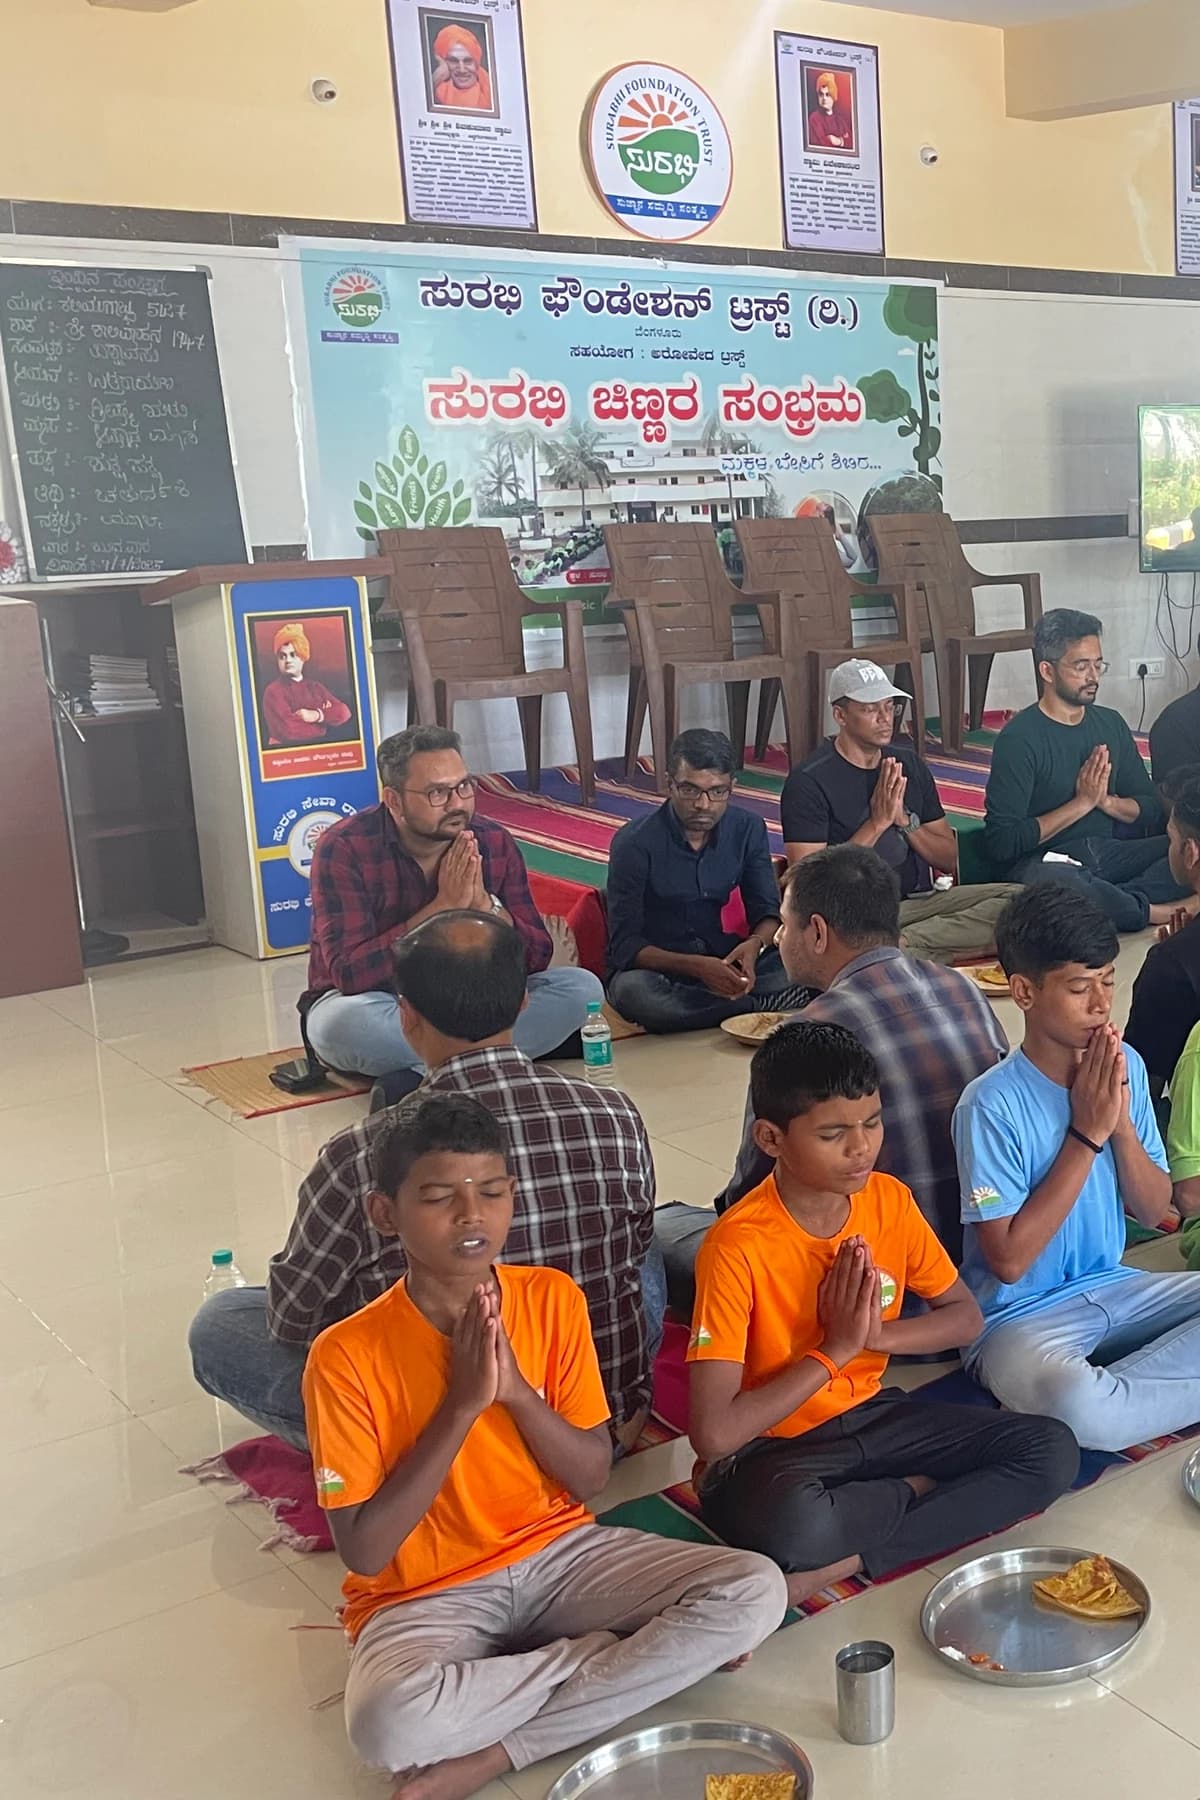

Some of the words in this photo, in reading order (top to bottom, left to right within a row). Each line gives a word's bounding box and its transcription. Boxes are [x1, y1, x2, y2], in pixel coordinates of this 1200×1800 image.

[605, 88, 626, 151] SURABHI
[624, 78, 701, 117] FOUNDATION
[697, 117, 713, 165] TRUST
[626, 148, 699, 184] ಸುರಭಿ
[419, 272, 522, 315] ಸುರಭಿ
[541, 277, 712, 319] ಫೌಂಡೇಶನ್
[729, 292, 792, 338] ಟ್ರಸ್ಟ್
[808, 296, 859, 331] (ರಿ.)
[172, 330, 206, 352] 1947
[634, 326, 682, 338] ಬೆಂಗಳೂರು
[570, 345, 634, 359] ಸಹಯೋಗ
[651, 348, 714, 362] ಅರೋವೇದ
[721, 350, 746, 368] ಟ್ರಸ್ಟ್
[428, 372, 567, 427] ಸುರಭಿ
[593, 377, 699, 443] ಚಿಣ್ಣರ
[723, 379, 862, 437] ಸಂಭ್ರಮ
[721, 457, 768, 479] ಮಕ್ಕಳ
[775, 452, 825, 473] ಬೇಸಿಗೆ
[408, 480, 418, 514] Friends
[384, 503, 401, 524] Love
[428, 497, 448, 526] Health
[301, 796, 336, 810] ಸೇವಾ
